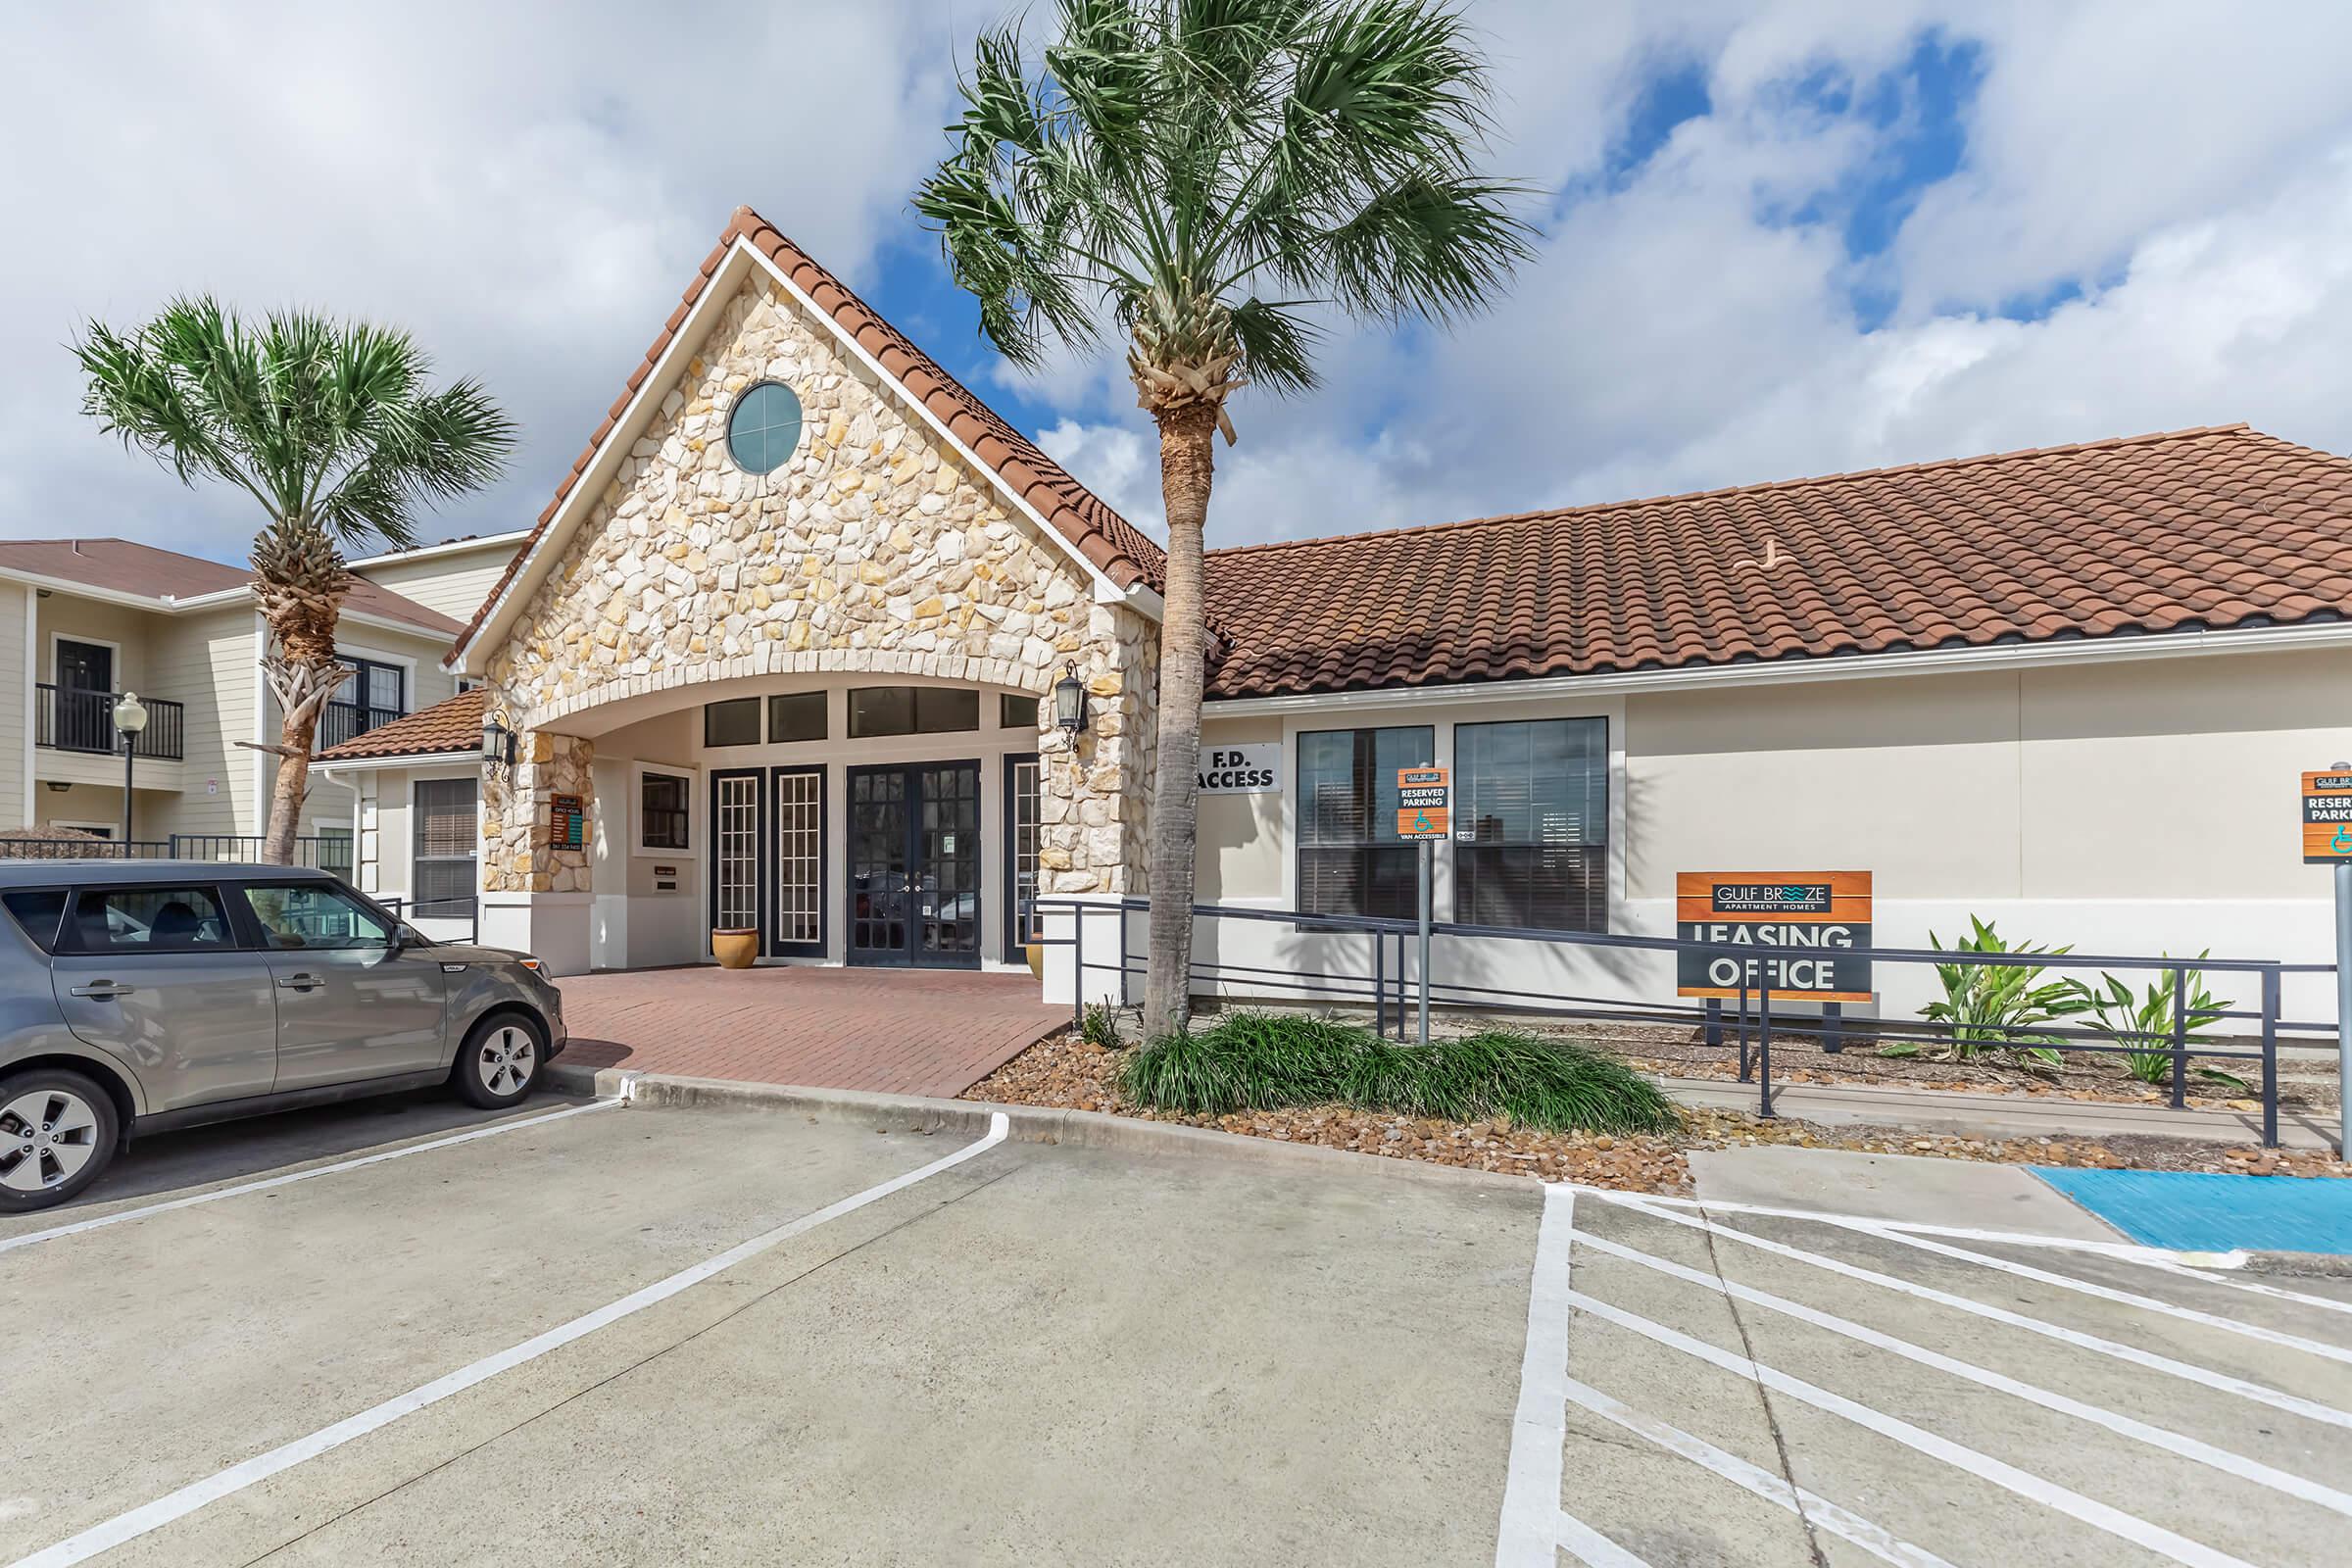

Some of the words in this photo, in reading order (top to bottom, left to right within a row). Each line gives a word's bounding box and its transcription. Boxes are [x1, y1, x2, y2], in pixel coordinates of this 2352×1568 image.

[1212, 751, 1251, 768] F.D.
[1401, 788, 1445, 798] RESERVED
[1403, 798, 1444, 807] PARKING
[2308, 798, 2352, 808] RESER
[1717, 886, 1758, 901] GULF
